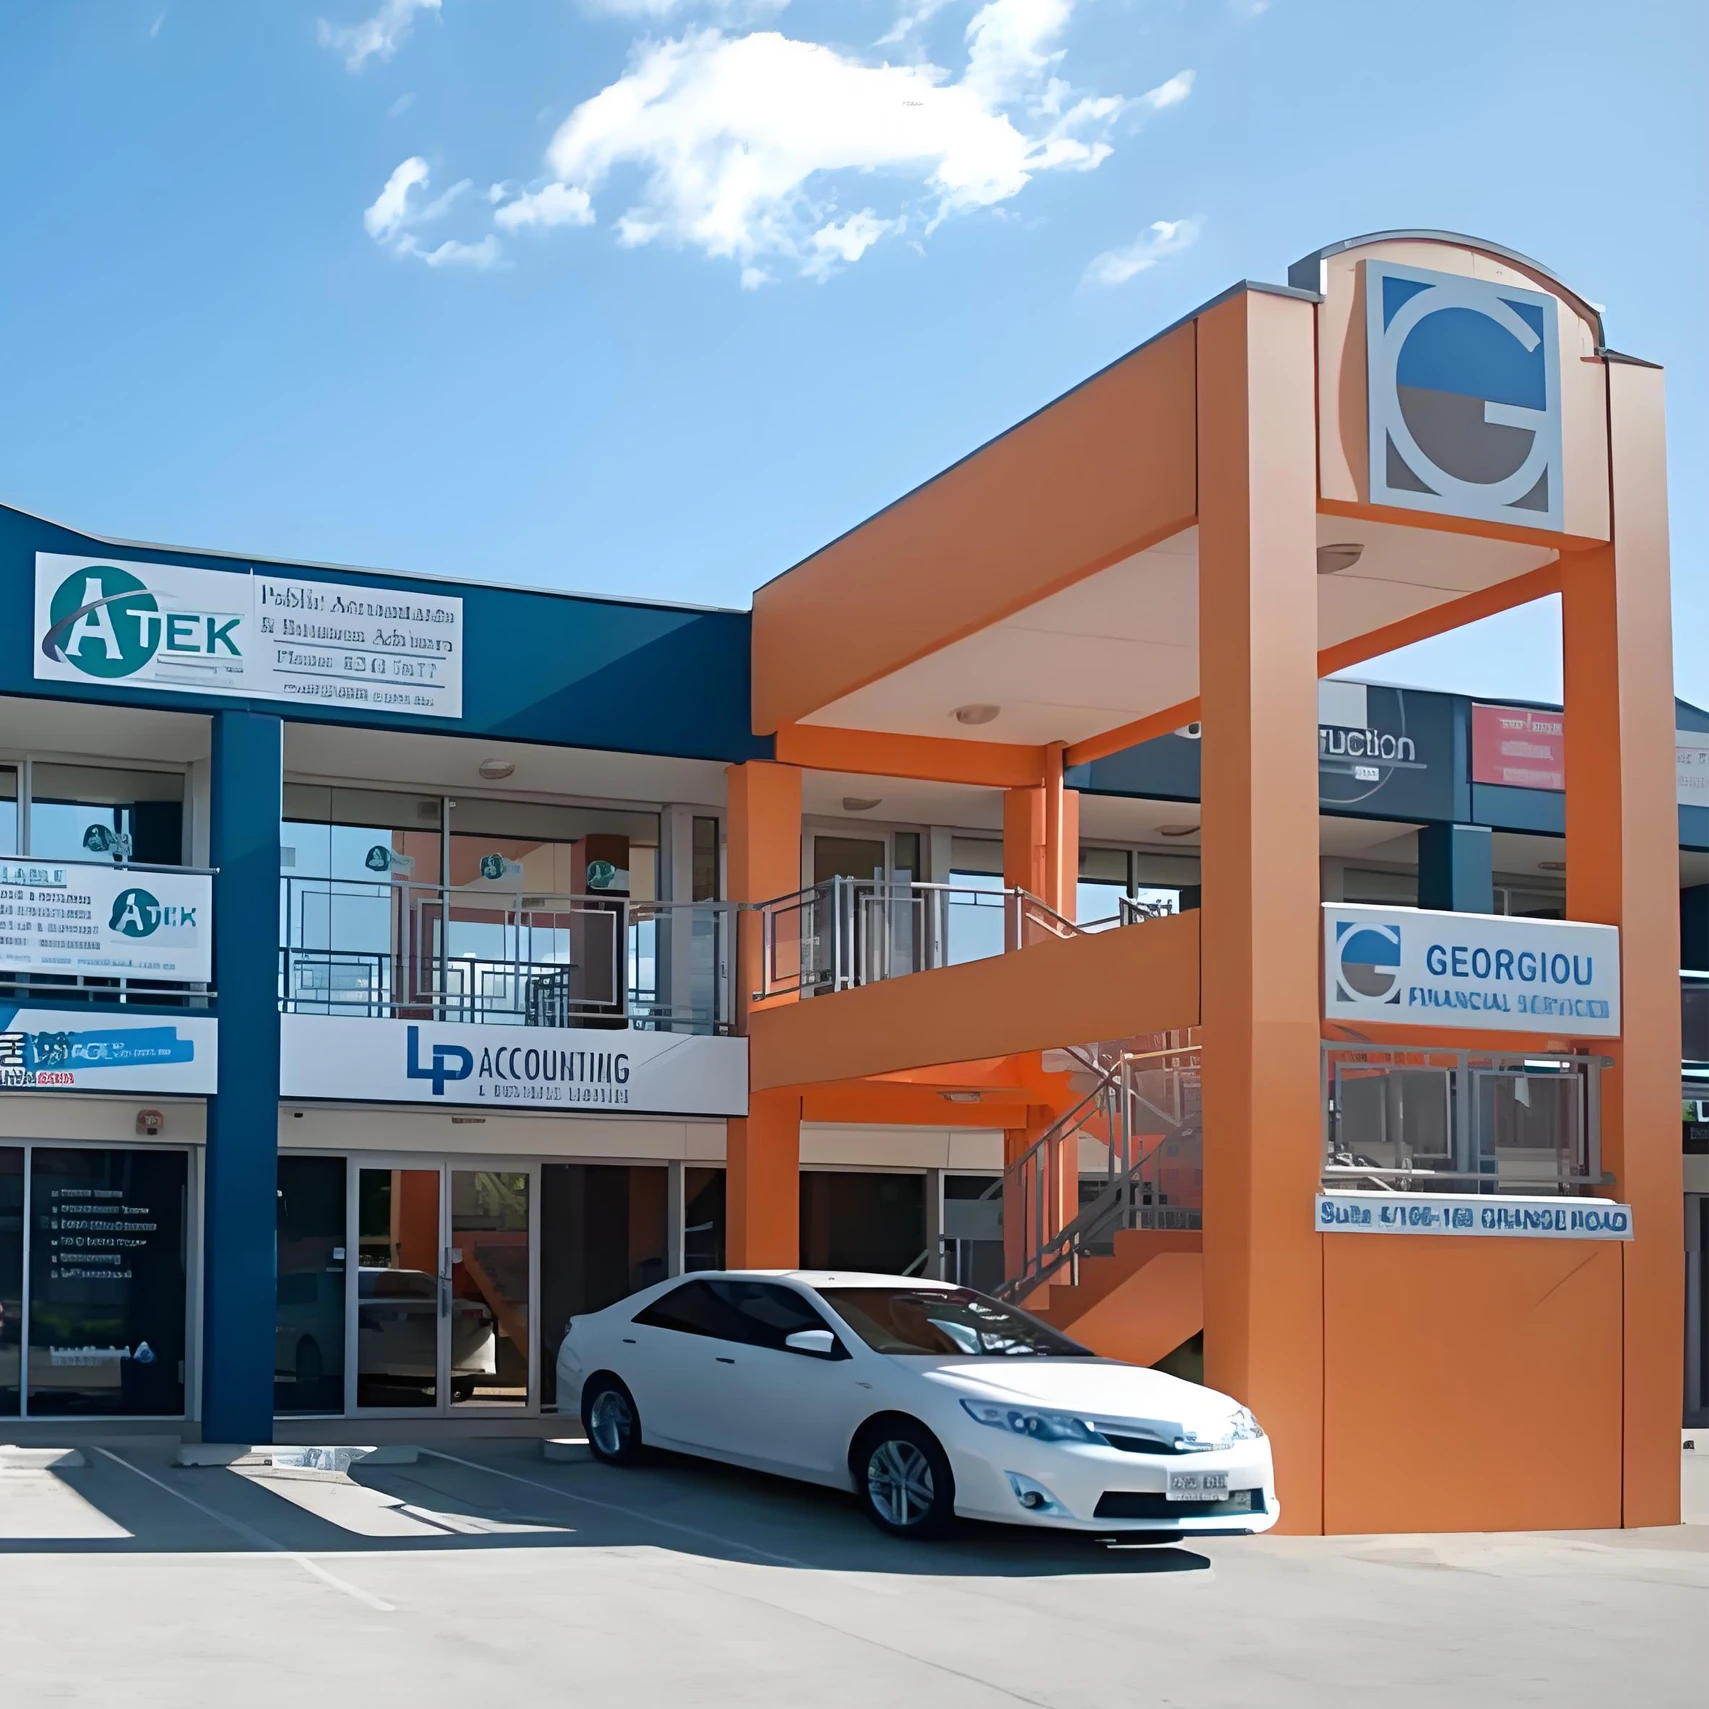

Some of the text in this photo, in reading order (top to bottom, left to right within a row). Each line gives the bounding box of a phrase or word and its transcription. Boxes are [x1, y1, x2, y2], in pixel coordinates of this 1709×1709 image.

[1426, 944, 1593, 986] GEORGIOU
[406, 1025, 630, 1096] LP ACCOUNTING
